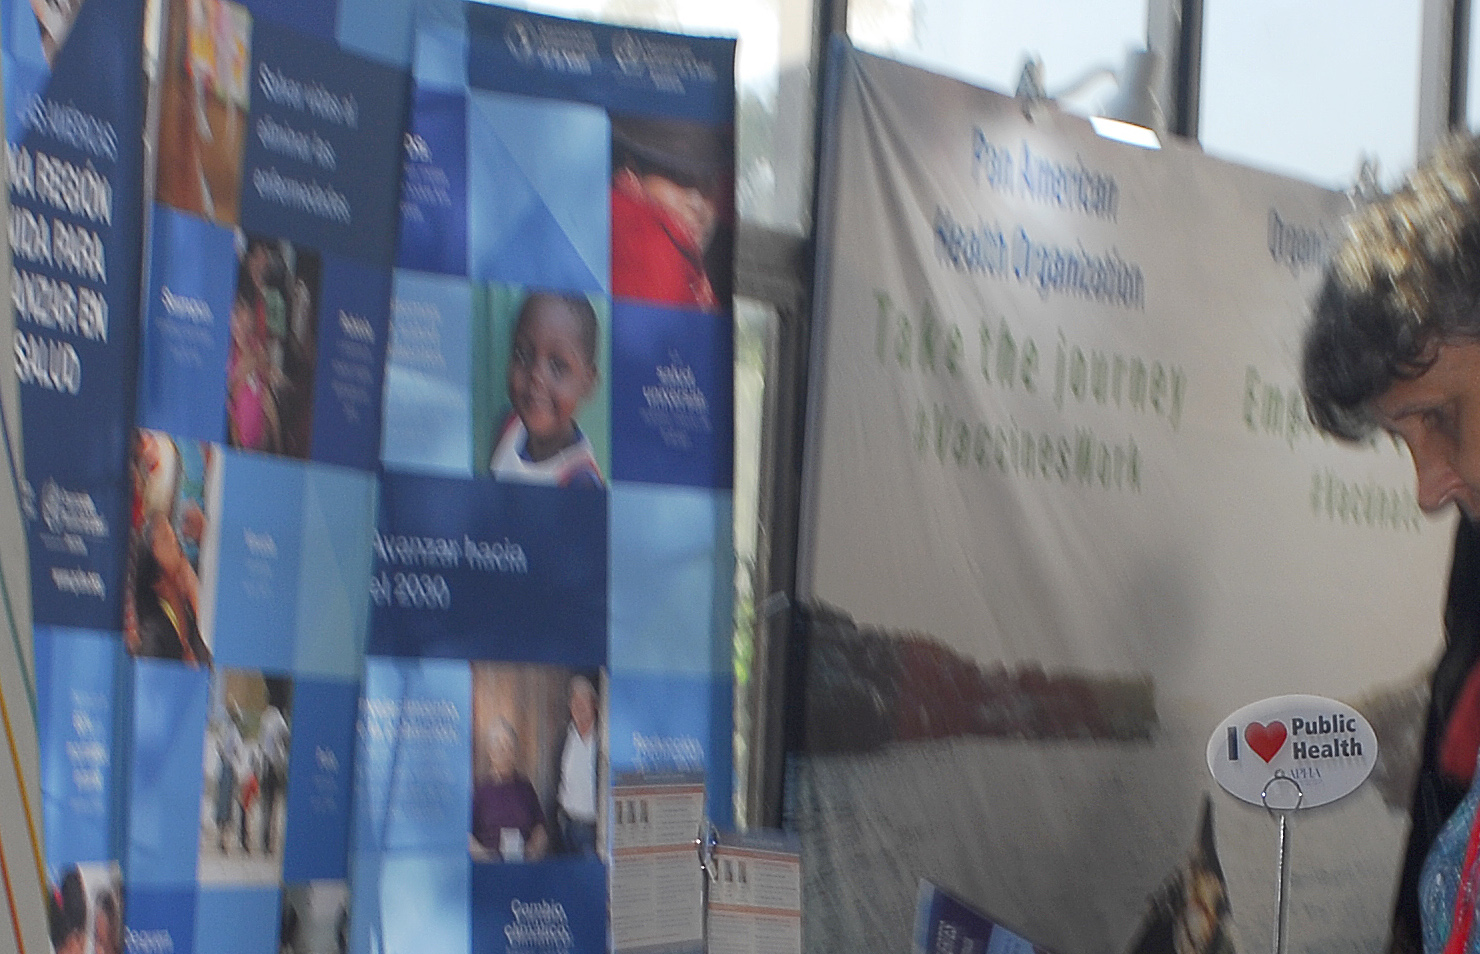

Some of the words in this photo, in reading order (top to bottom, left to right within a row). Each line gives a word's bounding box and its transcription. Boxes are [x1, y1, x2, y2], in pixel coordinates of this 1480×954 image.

[971, 123, 1014, 193] Pan
[1020, 138, 1120, 224] American
[1011, 224, 1145, 311] Organization
[14, 330, 82, 396] SALUD
[871, 286, 964, 378] Take
[978, 315, 1040, 394] the
[1052, 326, 1188, 432] journey
[394, 571, 451, 610] 2030
[1227, 726, 1239, 761] I
[1291, 714, 1357, 736] Public
[1292, 738, 1363, 760] Health
